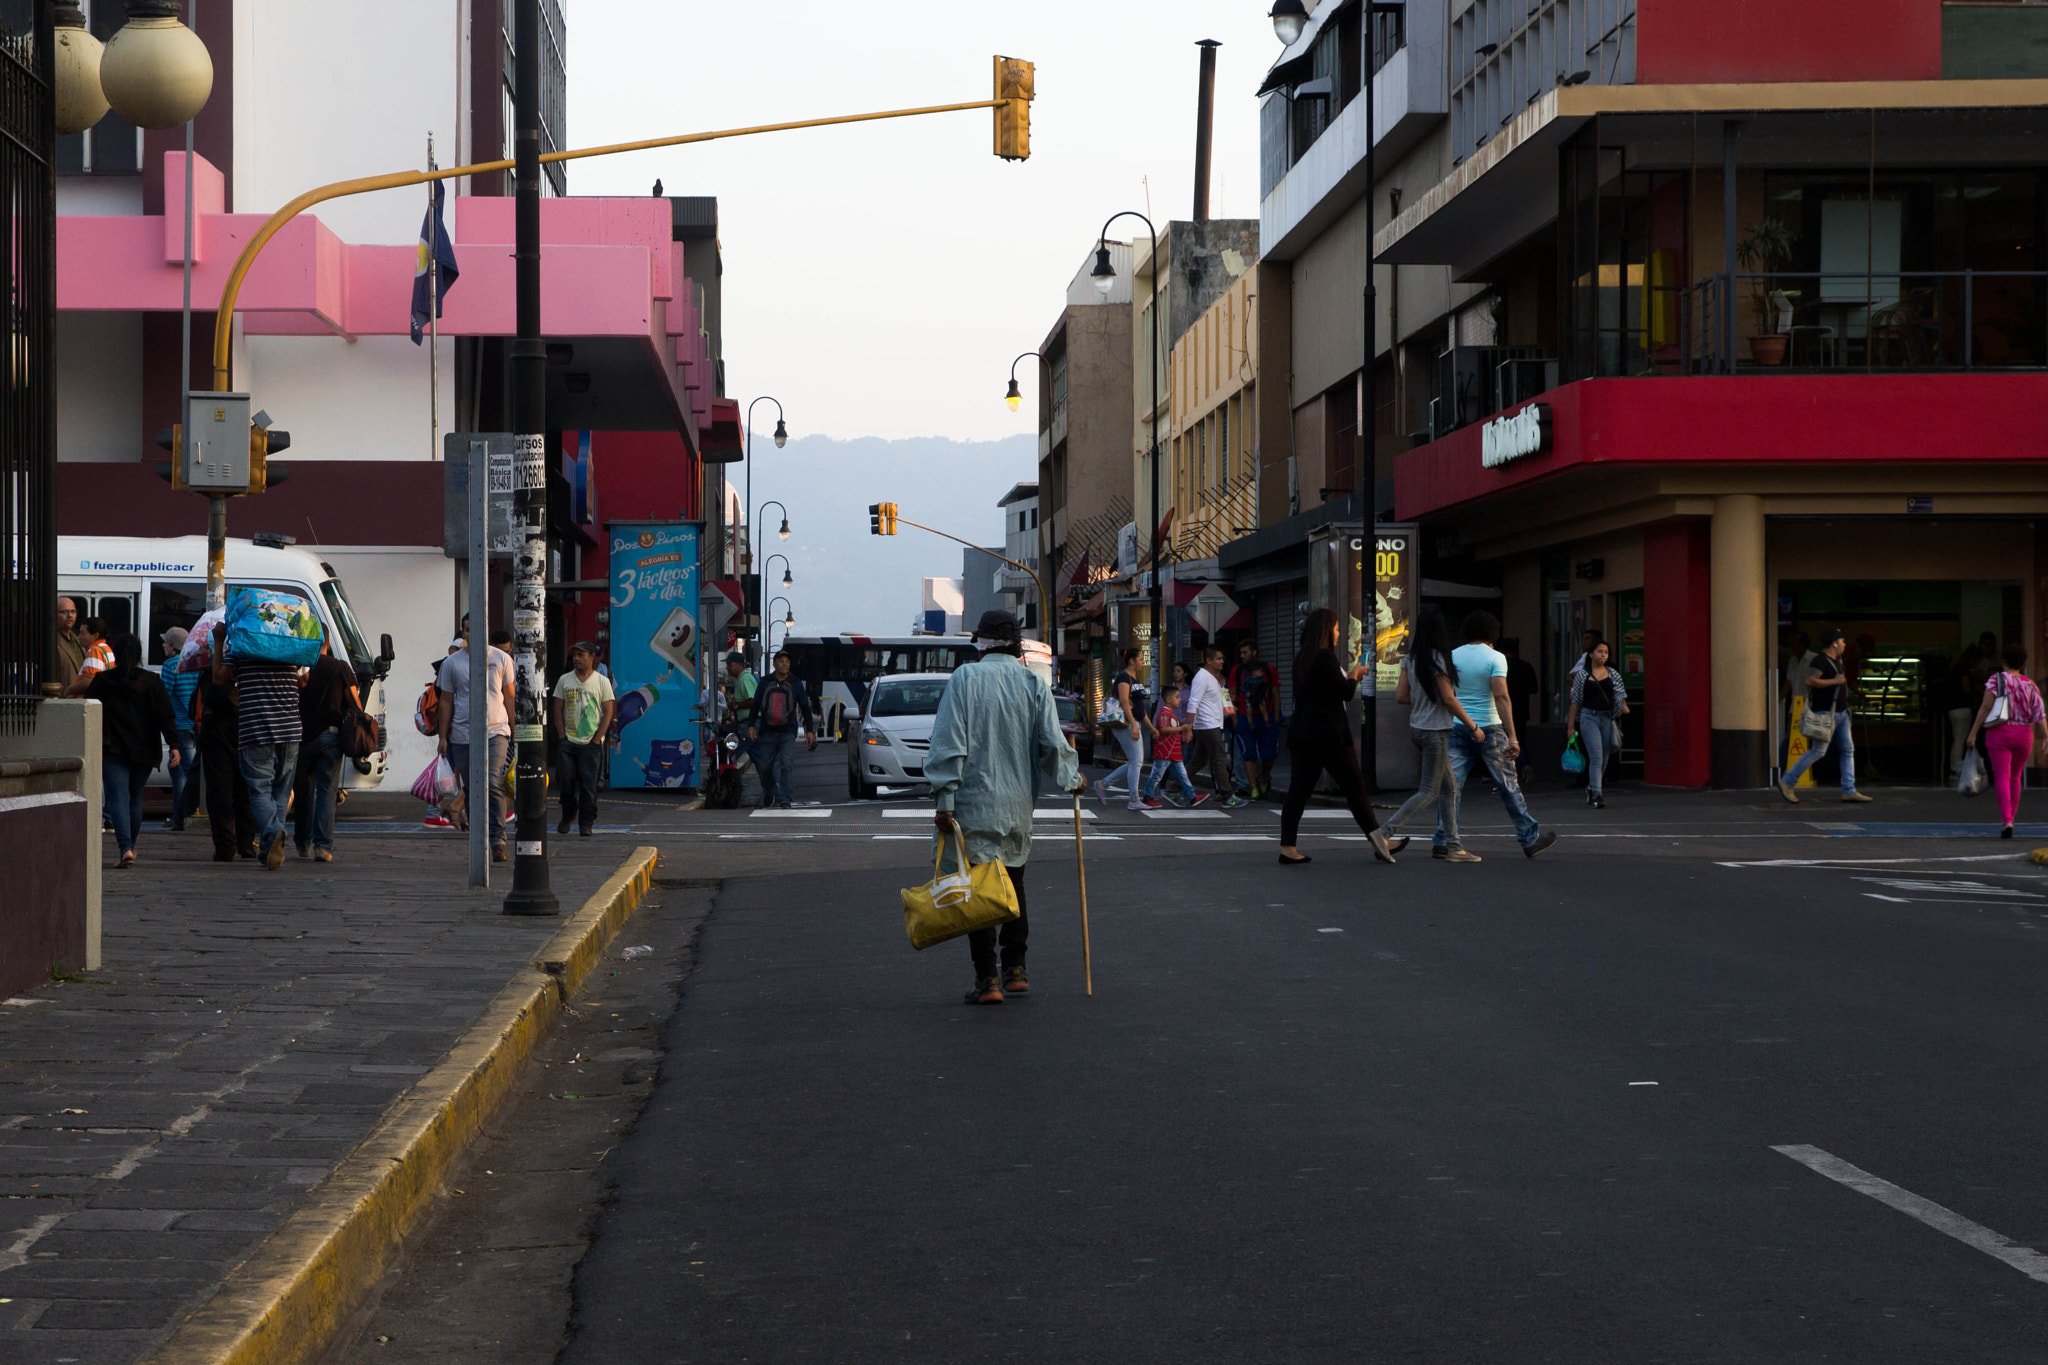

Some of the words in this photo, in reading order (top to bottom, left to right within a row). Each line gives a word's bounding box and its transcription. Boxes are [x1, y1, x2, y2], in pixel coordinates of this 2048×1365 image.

[655, 532, 696, 545] Pinos
[1350, 538, 1406, 551] CNO
[93, 561, 195, 572] fuerzapublicacr
[610, 569, 636, 608] 3
[637, 565, 696, 590] lácteos
